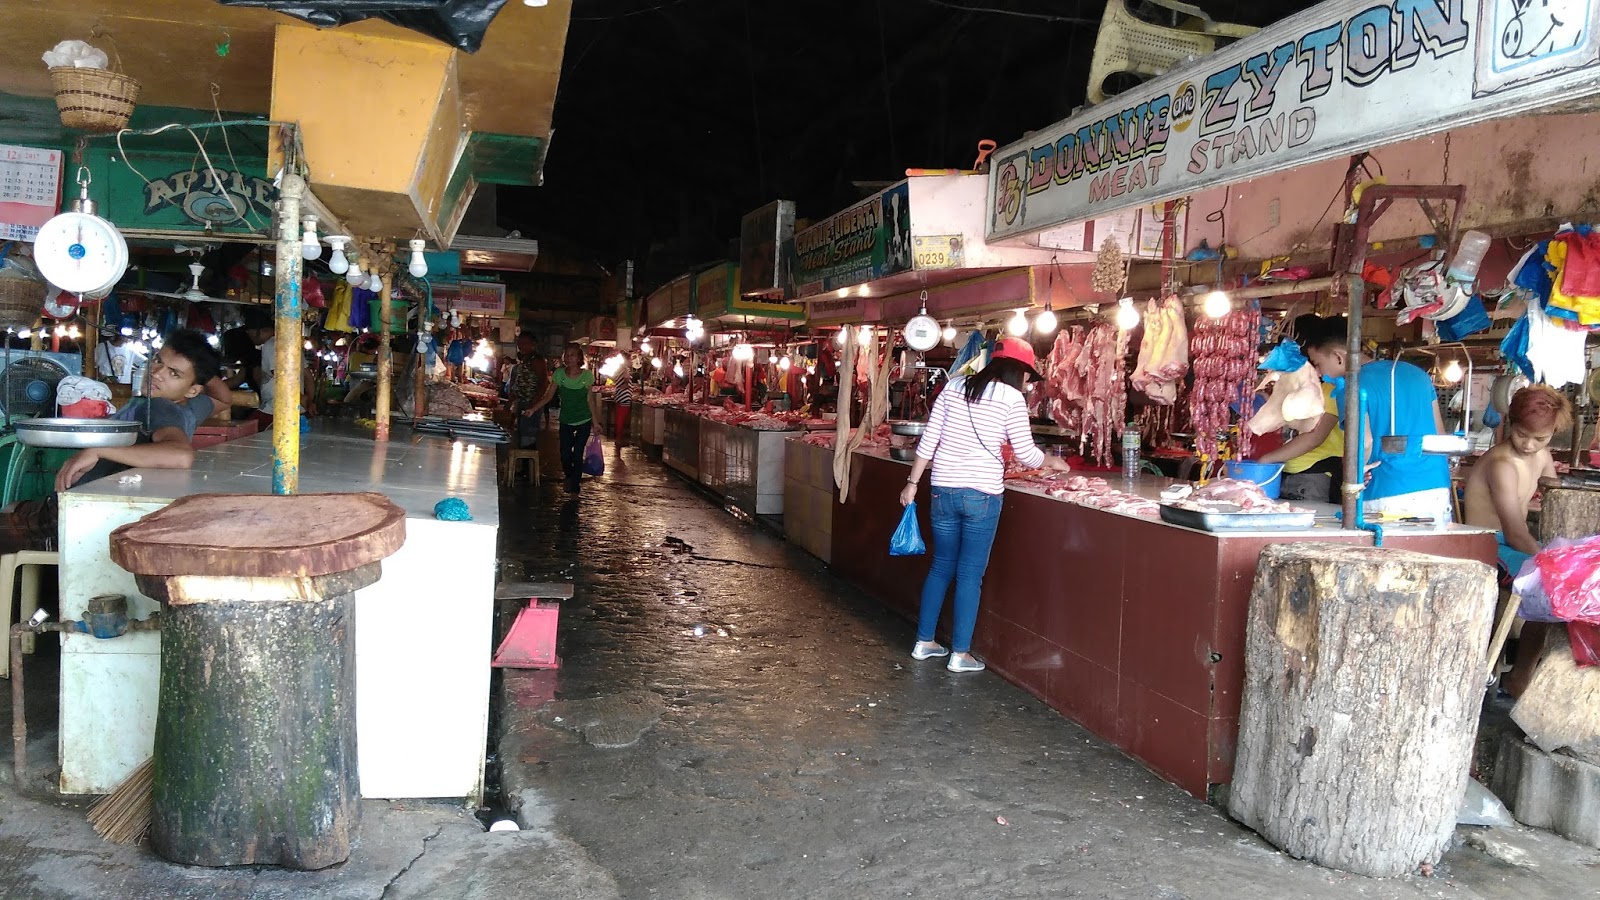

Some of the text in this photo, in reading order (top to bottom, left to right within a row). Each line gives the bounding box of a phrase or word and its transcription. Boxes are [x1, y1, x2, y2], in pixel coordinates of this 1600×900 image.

[1027, 94, 1171, 196] DONNIE
[1199, 0, 1469, 137] ZYTON
[25, 152, 40, 160] 2017
[1089, 106, 1317, 204] MEAT STAND
[144, 167, 275, 210] APPLE
[801, 246, 830, 270] Meat
[833, 228, 876, 262] Stand
[918, 252, 944, 265] 0239
